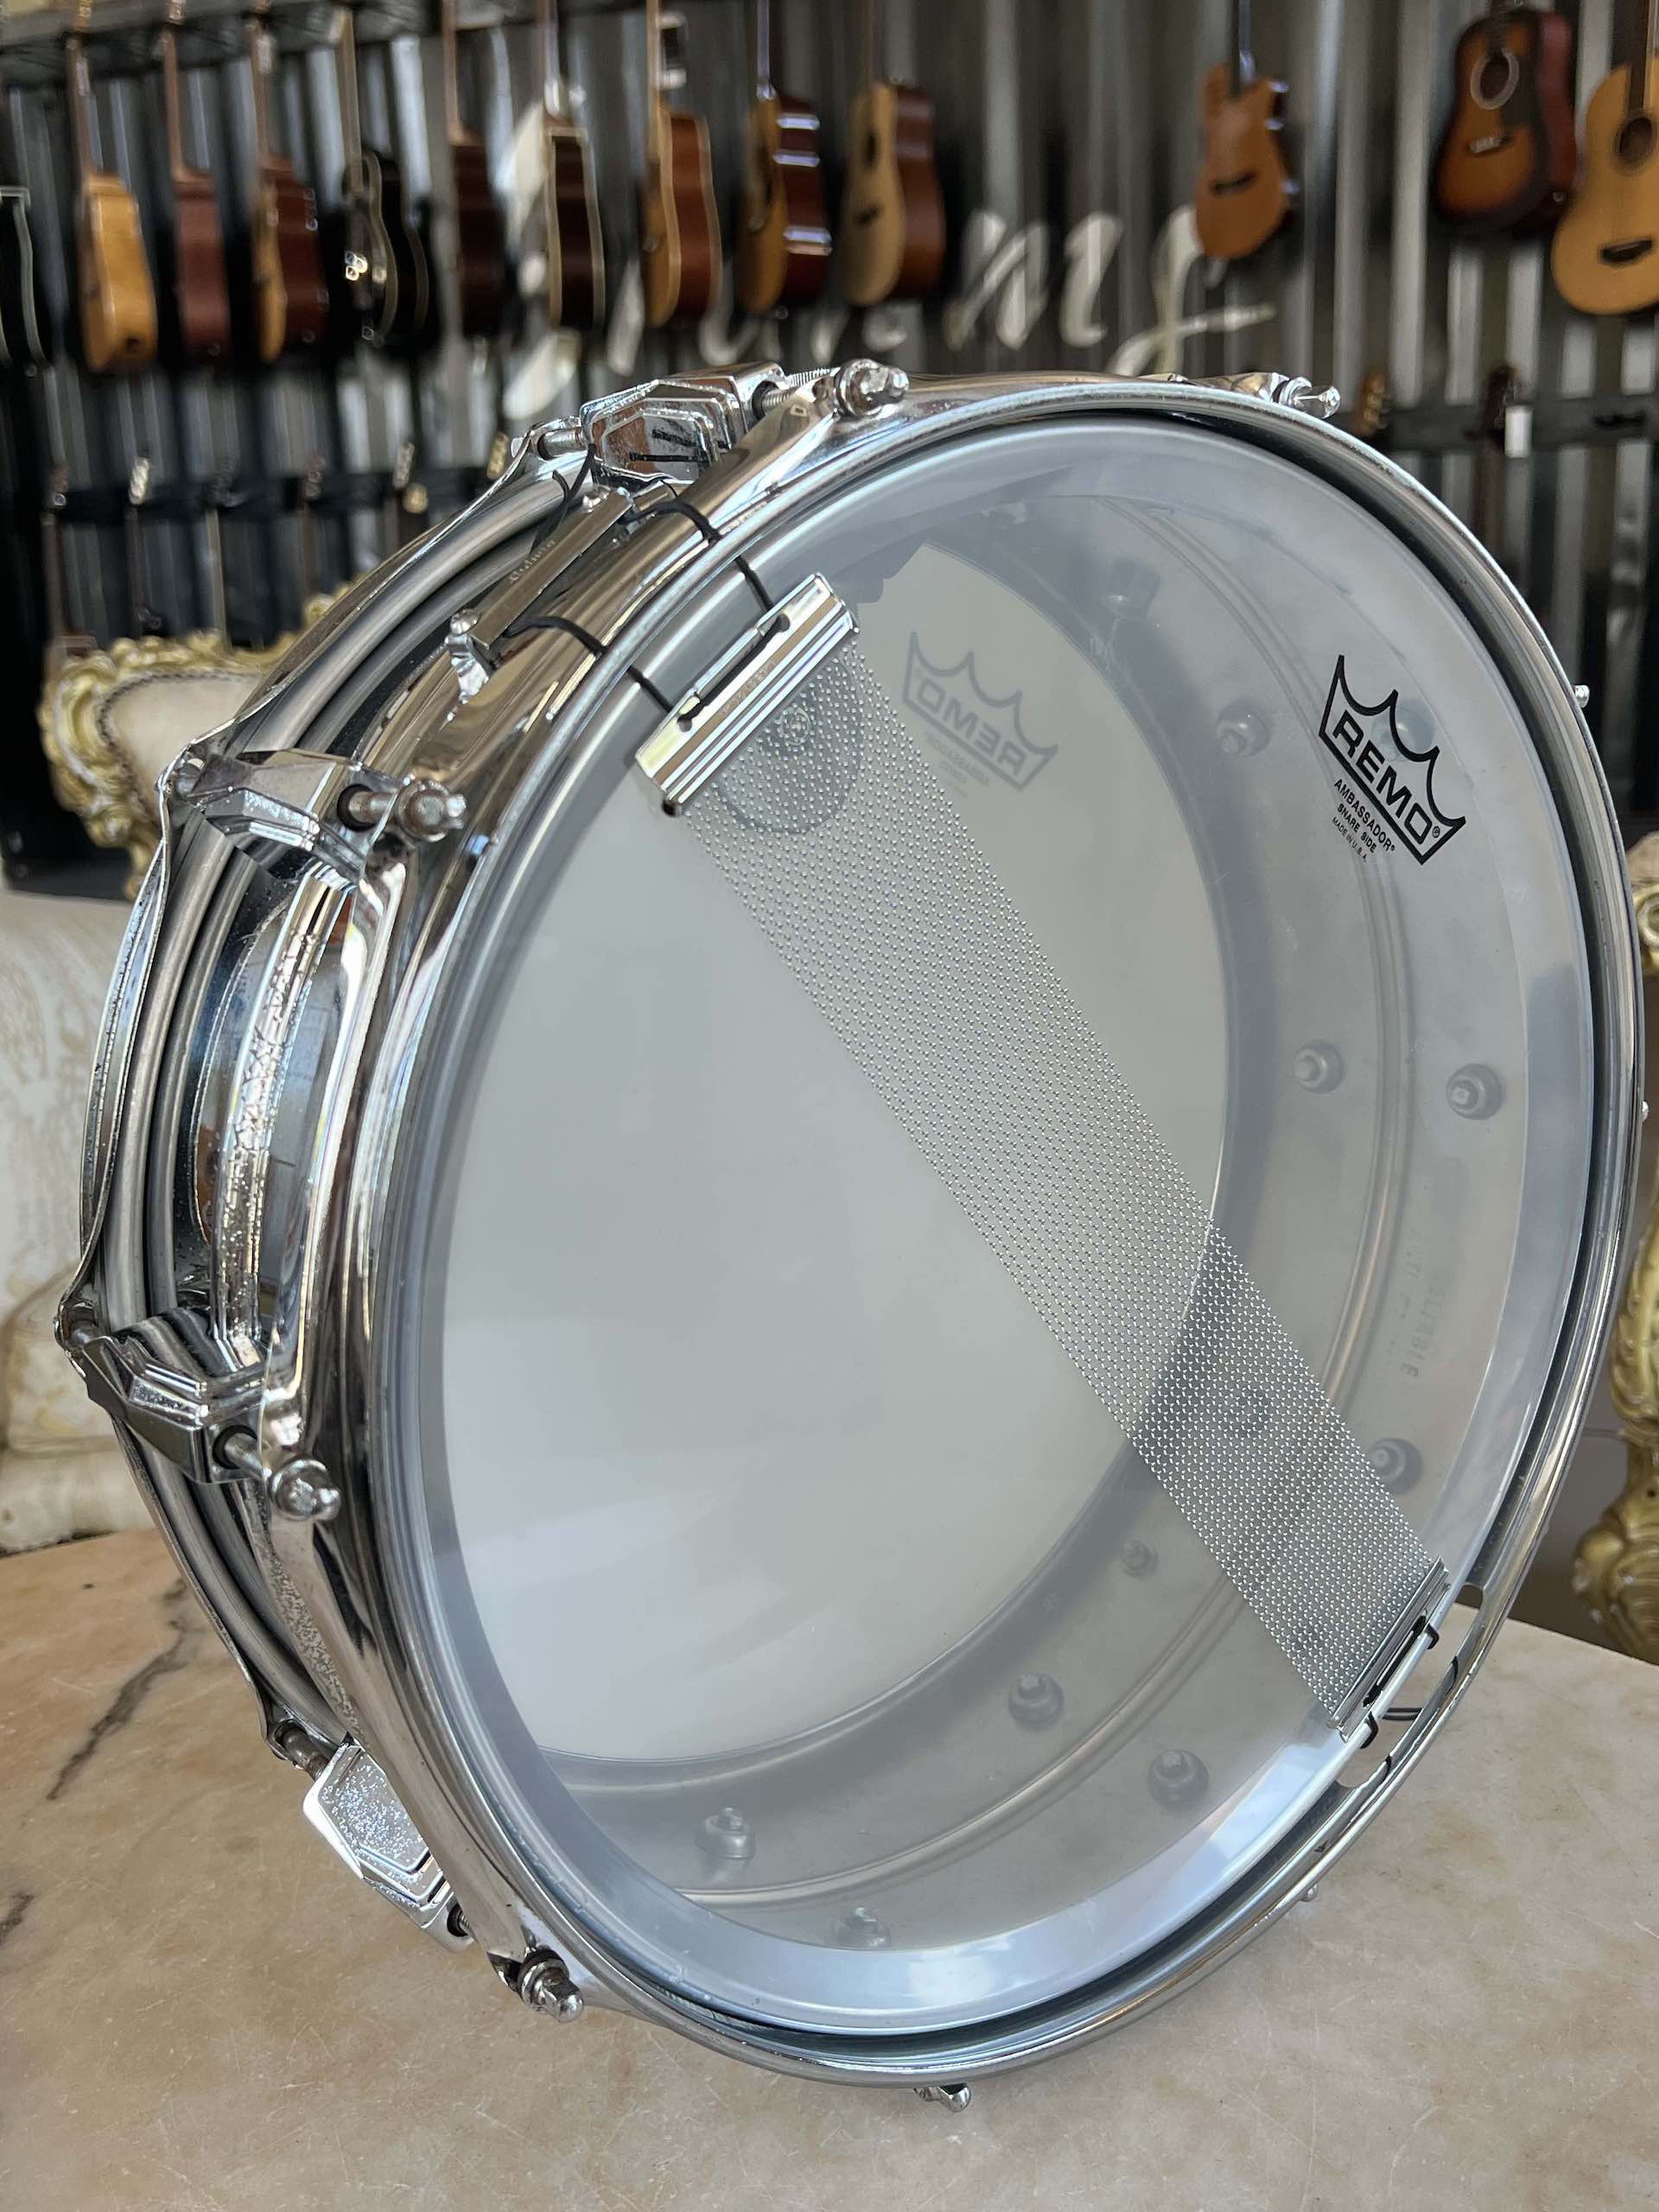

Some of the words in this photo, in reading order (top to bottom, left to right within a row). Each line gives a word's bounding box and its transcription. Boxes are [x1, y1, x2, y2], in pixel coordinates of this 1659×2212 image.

[1332, 817, 1348, 836] MADE
[1338, 803, 1360, 833] SNARE
[1361, 831, 1376, 853] SIDE
